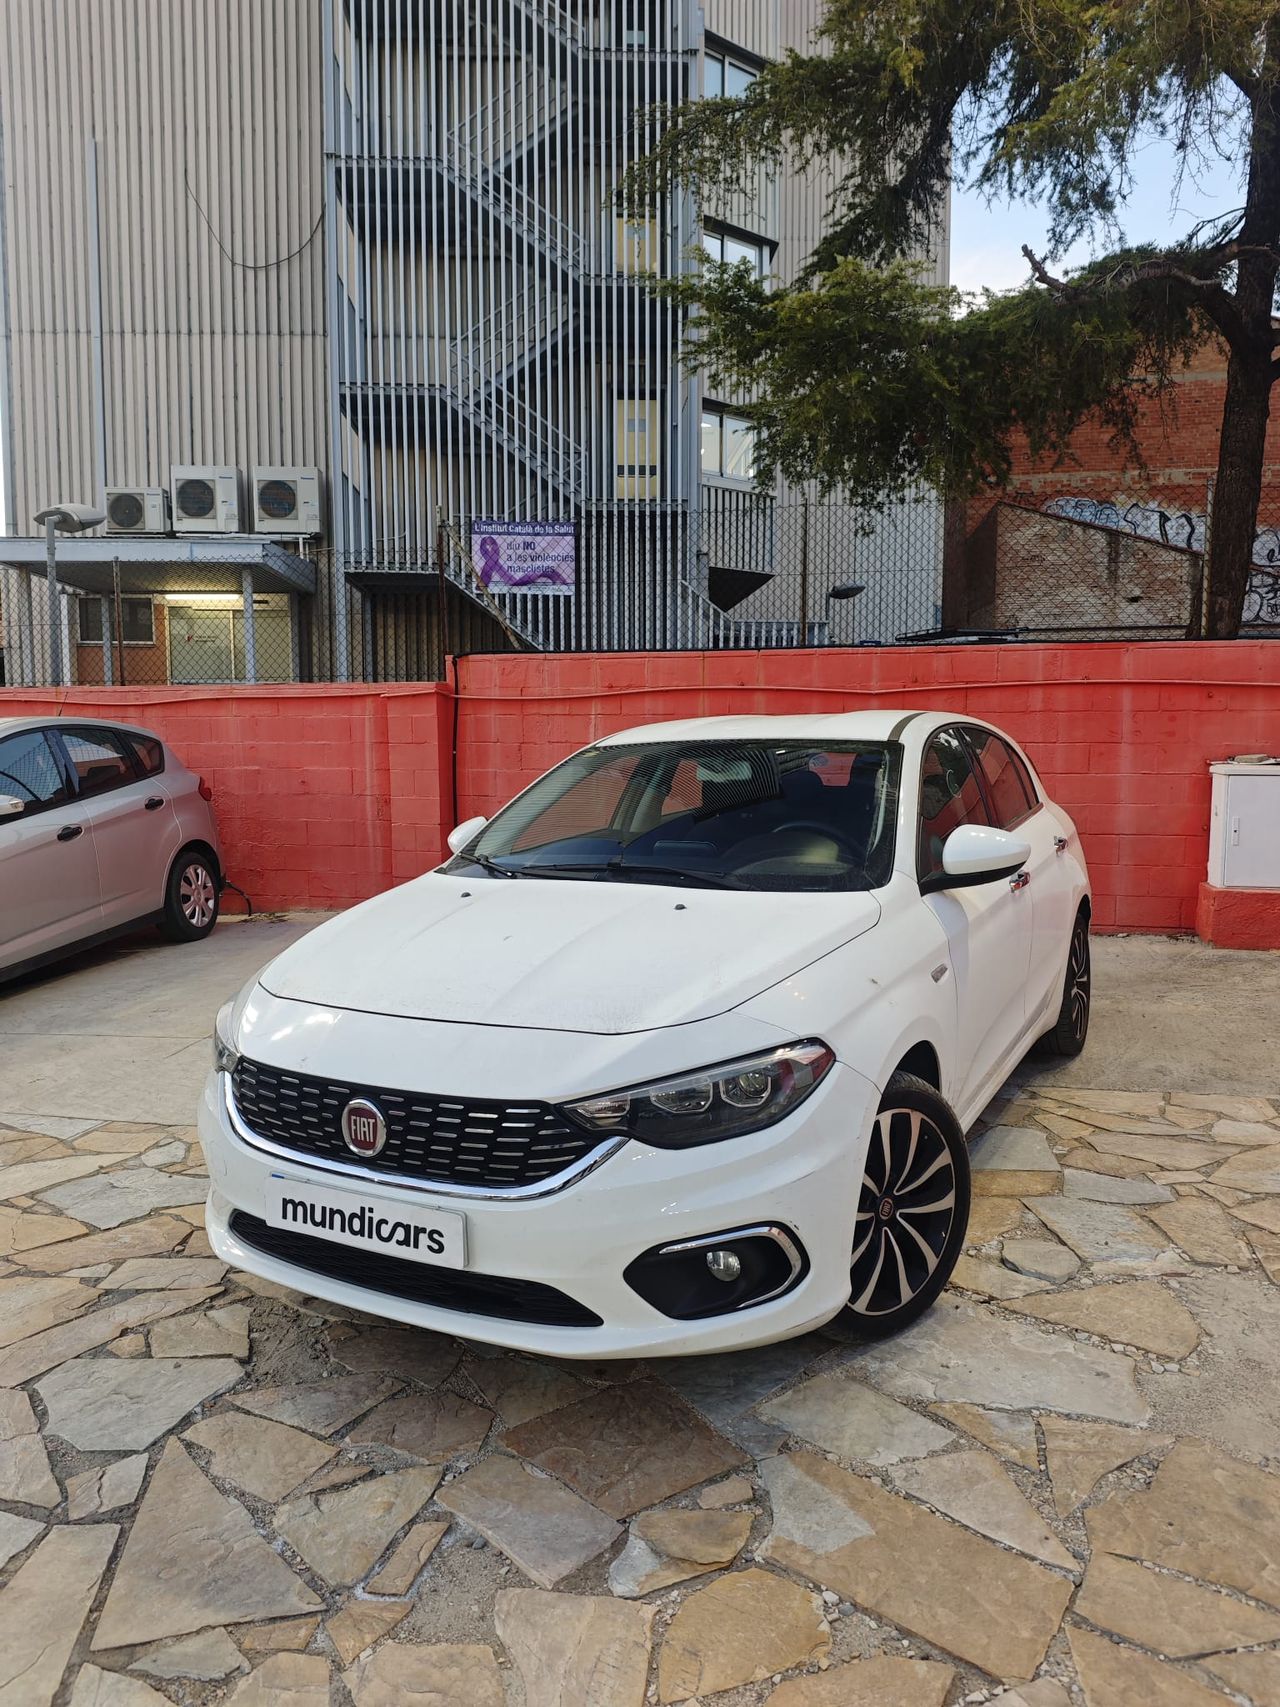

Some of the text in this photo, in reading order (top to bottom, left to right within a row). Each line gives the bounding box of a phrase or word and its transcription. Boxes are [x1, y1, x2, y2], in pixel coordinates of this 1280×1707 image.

[534, 524, 545, 533] de
[545, 525, 553, 533] la
[554, 525, 574, 534] Salut
[522, 541, 536, 550] NO
[514, 552, 528, 561] les
[506, 564, 555, 573] masclistes
[350, 1115, 376, 1142] FIAT
[281, 1197, 445, 1254] mundicars
